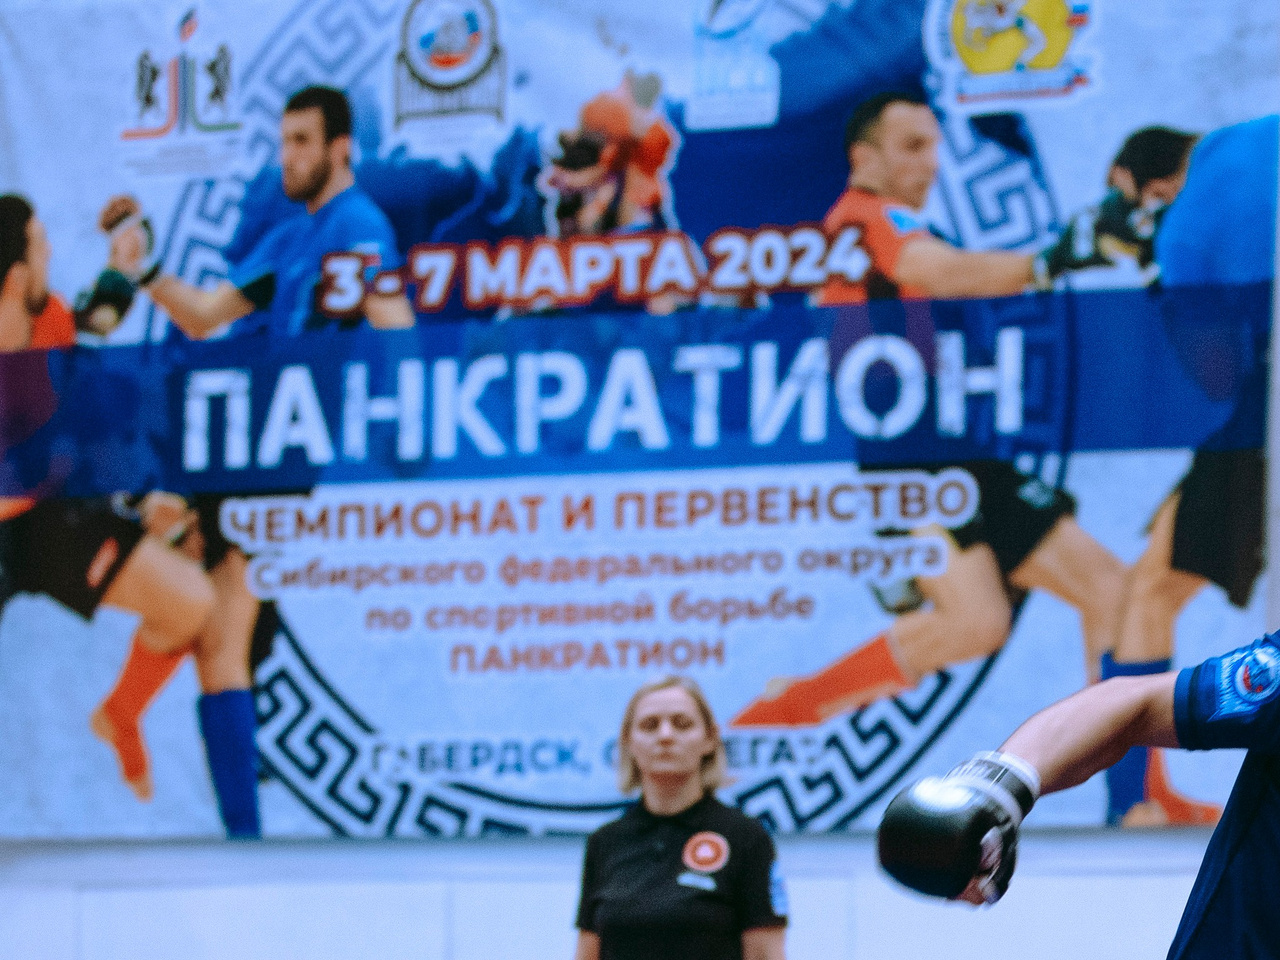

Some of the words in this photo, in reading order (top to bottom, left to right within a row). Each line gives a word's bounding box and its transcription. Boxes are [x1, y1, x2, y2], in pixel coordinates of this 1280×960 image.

[321, 257, 363, 312] 3
[414, 251, 456, 307] 7
[466, 237, 698, 300] МАРТА
[710, 226, 872, 289] 2024
[183, 328, 1025, 471] ПАНКРАТИОН
[230, 495, 546, 542] ЧЕМПИОНАТ
[562, 494, 595, 532] И
[614, 480, 969, 530] ПЕРВЕНСТВО
[256, 556, 487, 593] Сибирского
[501, 550, 785, 588] федерального
[798, 544, 942, 579] округа
[366, 606, 412, 631] по
[425, 594, 655, 633] спортивной
[668, 587, 815, 626] борьбе
[452, 638, 724, 672] ПАНКРАТИОН
